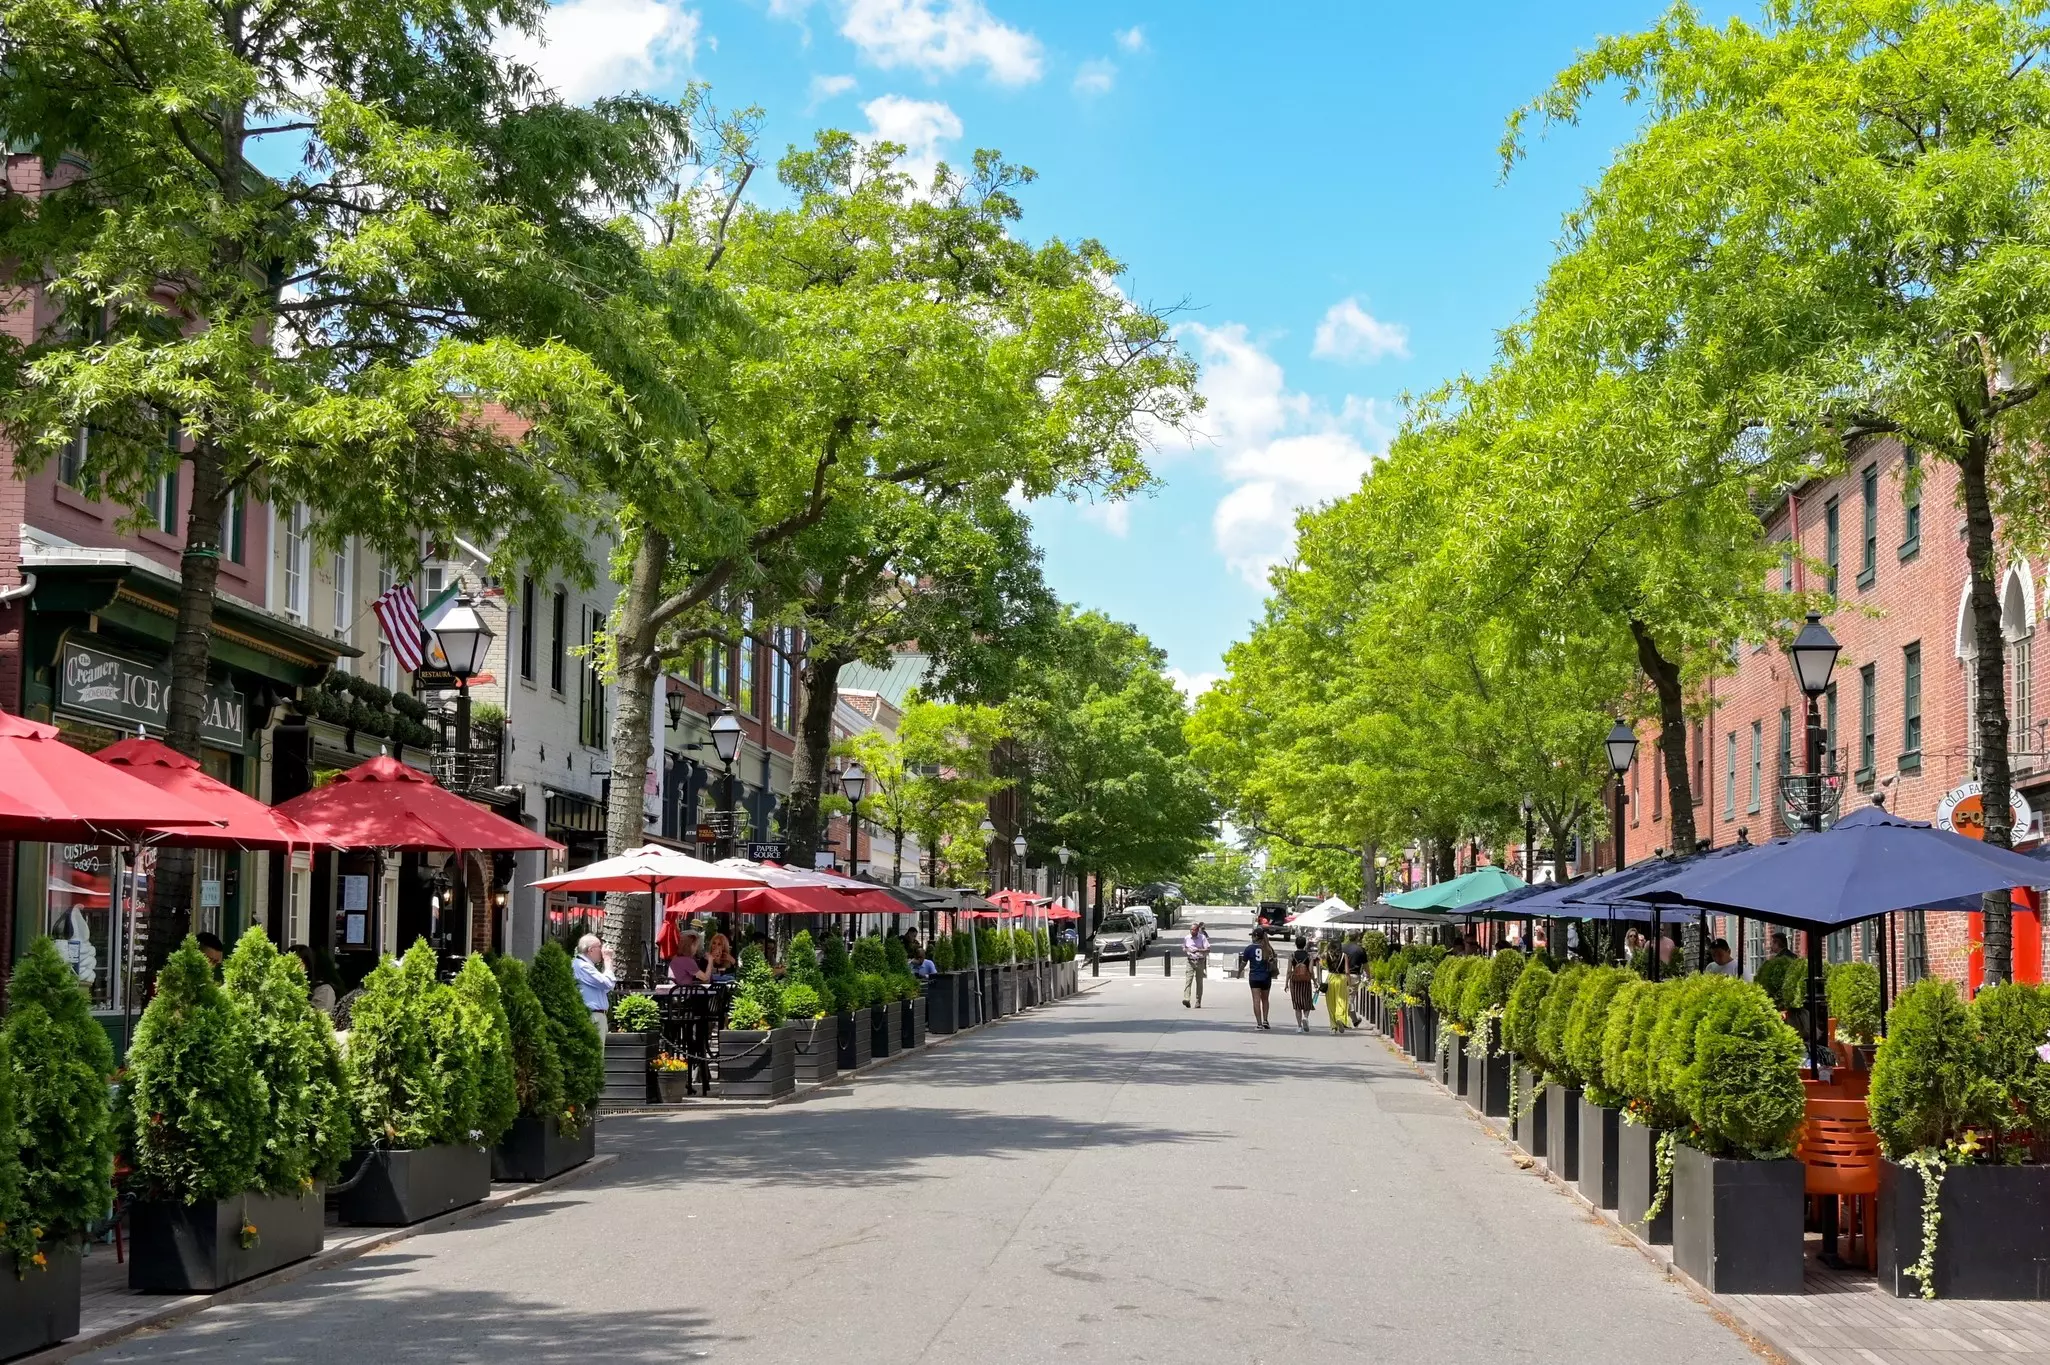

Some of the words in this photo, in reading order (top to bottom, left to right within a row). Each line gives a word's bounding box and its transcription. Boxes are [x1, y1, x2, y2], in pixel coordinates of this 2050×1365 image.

[67, 656, 120, 687] Creamery
[121, 672, 160, 714] ICE
[1945, 789, 1965, 809] OLD
[753, 851, 781, 859] SOURCE
[1255, 948, 1262, 962] 9
